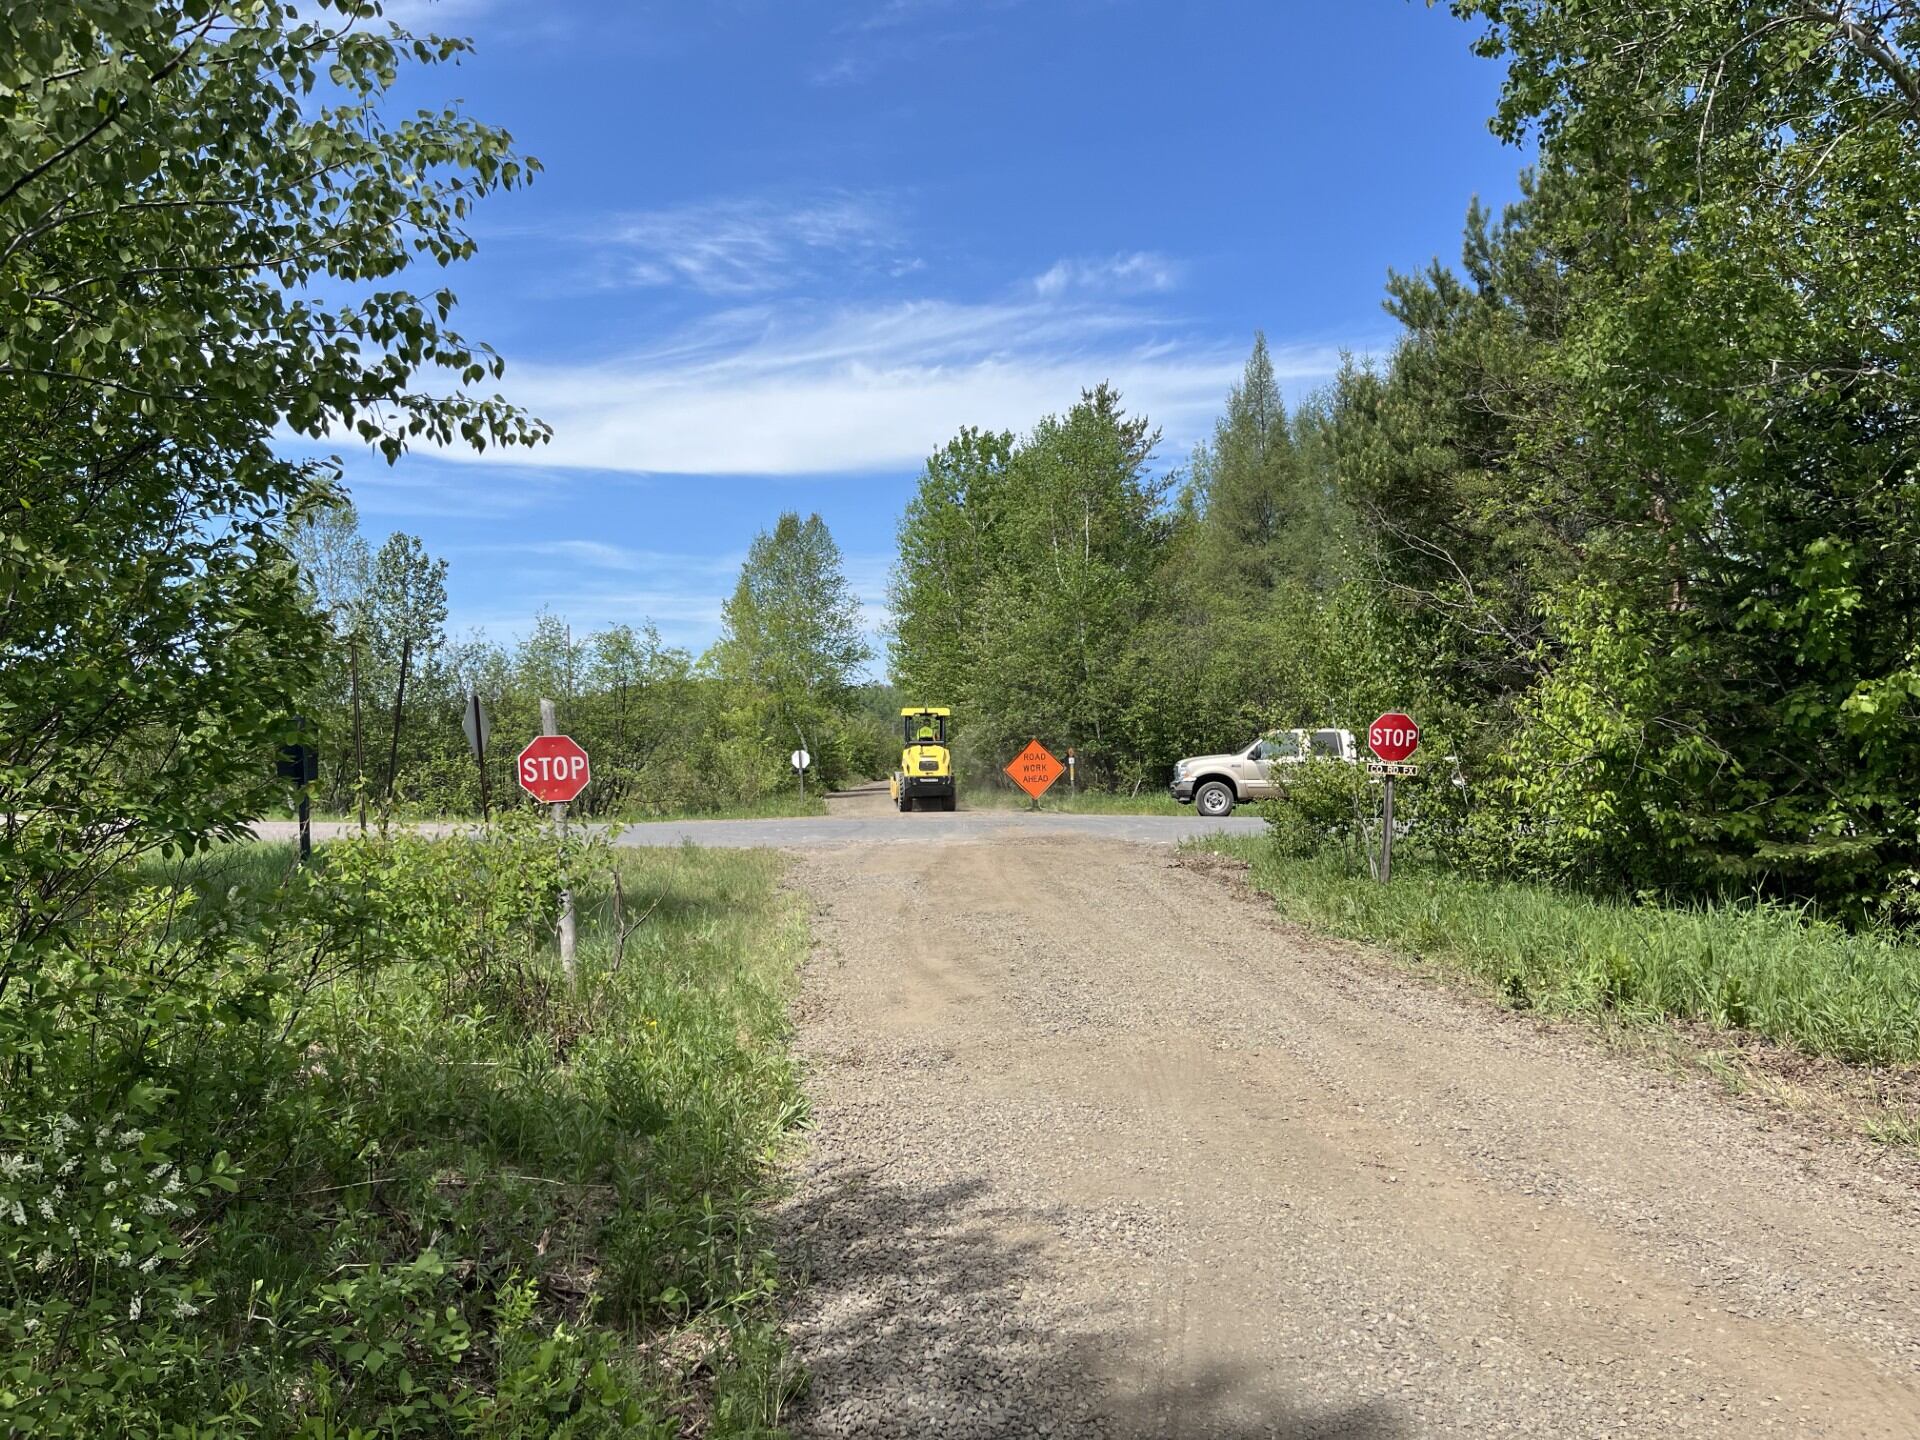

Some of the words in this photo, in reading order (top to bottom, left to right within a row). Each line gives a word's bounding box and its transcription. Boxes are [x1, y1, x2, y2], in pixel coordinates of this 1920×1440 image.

[1371, 728, 1417, 747] STOP
[1023, 753, 1046, 761] ROAD
[523, 756, 585, 782] STOP
[1023, 764, 1047, 772] WORK
[1022, 775, 1049, 783] AHEAD
